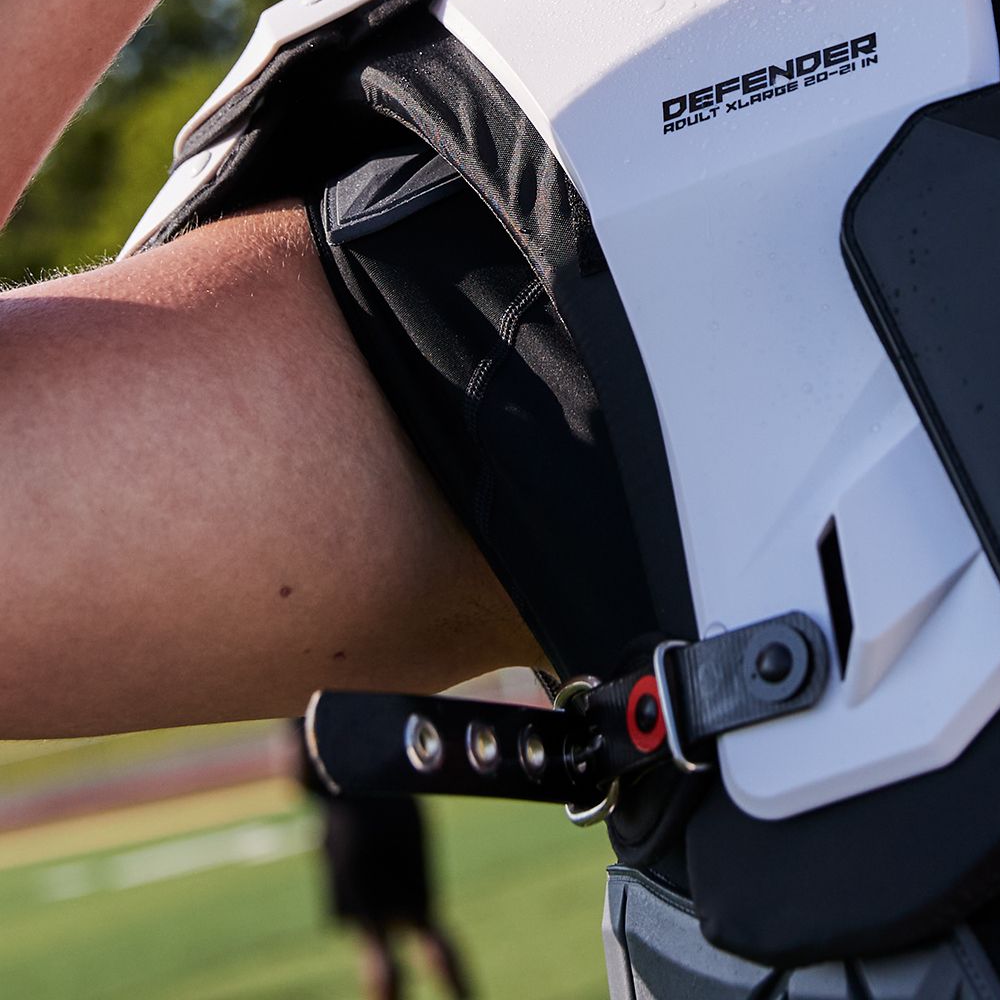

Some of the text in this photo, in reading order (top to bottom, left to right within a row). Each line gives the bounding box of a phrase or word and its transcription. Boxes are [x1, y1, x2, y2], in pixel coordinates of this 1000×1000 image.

[662, 32, 877, 122] DEFENDER
[663, 54, 878, 135] ADULT XLARGE 20-21 IN
